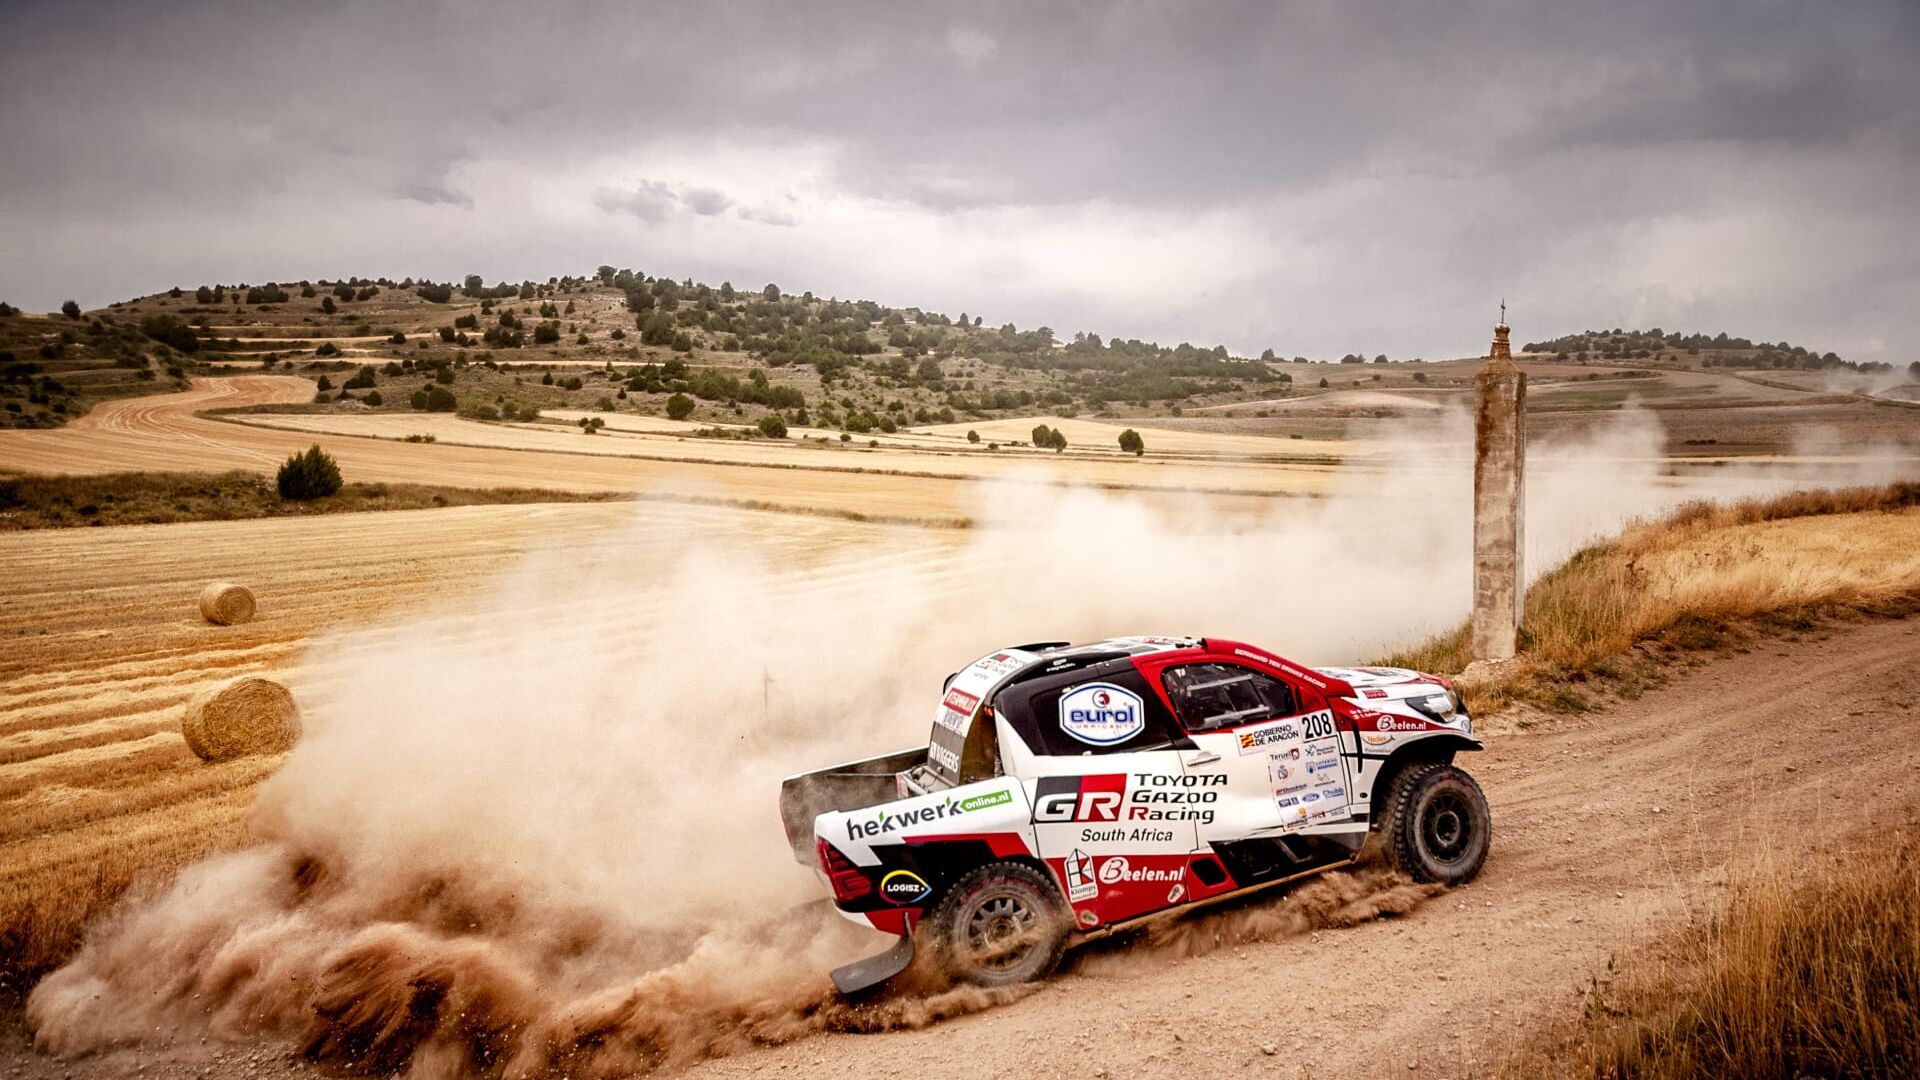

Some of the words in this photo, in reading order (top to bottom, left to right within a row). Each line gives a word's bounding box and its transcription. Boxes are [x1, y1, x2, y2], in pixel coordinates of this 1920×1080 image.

[1303, 674, 1327, 688] RACING
[1070, 705, 1134, 723] eurol
[1253, 724, 1292, 739] GOBIERNO
[1301, 713, 1333, 740] 208
[1378, 716, 1427, 732] Beelen.nl
[1255, 738, 1265, 746] DE
[1270, 751, 1291, 761] Teruel
[1034, 792, 1121, 821] GR
[1134, 773, 1228, 787] TOYOTA
[1132, 789, 1218, 804] GAZOO
[847, 797, 963, 841] hekwerk
[965, 791, 1010, 810] online.nl
[1128, 806, 1214, 825] Racing
[1081, 828, 1126, 842] South
[1129, 828, 1173, 842] Africa
[1101, 858, 1185, 883] Beelen.nl
